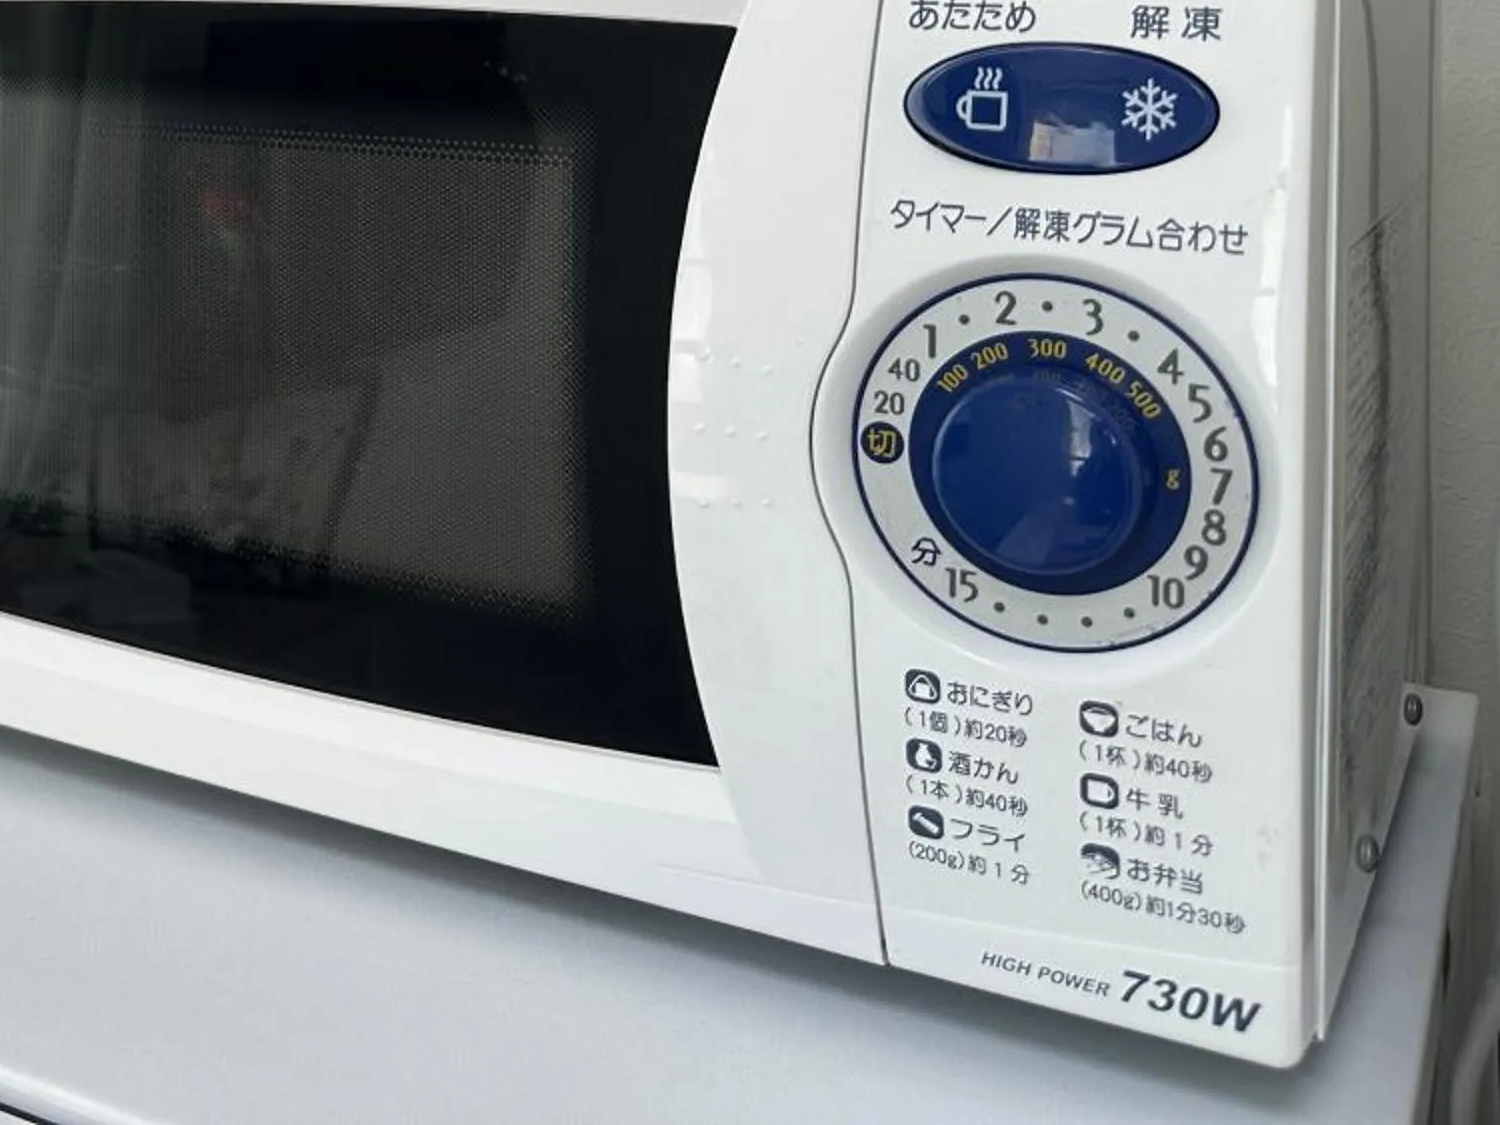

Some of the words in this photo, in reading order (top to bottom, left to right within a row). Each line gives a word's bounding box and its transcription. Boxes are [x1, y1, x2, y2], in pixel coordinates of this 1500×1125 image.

[1130, 5, 1224, 41] 解凍
[995, 291, 1017, 326] 2
[1082, 298, 1103, 336] 3
[923, 324, 937, 358] 1
[970, 343, 1009, 371] 200
[1028, 339, 1067, 360] 300
[888, 358, 921, 382] 40
[937, 364, 969, 394] 100
[1085, 352, 1126, 387] 400
[1157, 349, 1184, 385] 4
[873, 391, 905, 415] 20
[1127, 380, 1162, 421] 500
[1187, 384, 1213, 423] 5
[867, 428, 897, 456] 切
[1204, 426, 1229, 462] 6
[1209, 467, 1233, 505] 7
[1201, 510, 1227, 546] 8
[911, 536, 943, 566] 分
[1184, 545, 1208, 581] 9
[945, 568, 979, 602] 15
[1147, 575, 1185, 610] 10
[947, 681, 1034, 717] おにぎり
[1125, 713, 1204, 749] ごはん
[948, 750, 1020, 786] 酒かん
[1125, 786, 1185, 820] 牛乳
[949, 817, 1026, 853] フライ
[1126, 857, 1205, 896] お弁当
[981, 950, 1032, 978] HIGH
[1037, 965, 1112, 998] POWER
[1120, 968, 1263, 1034] 730W
